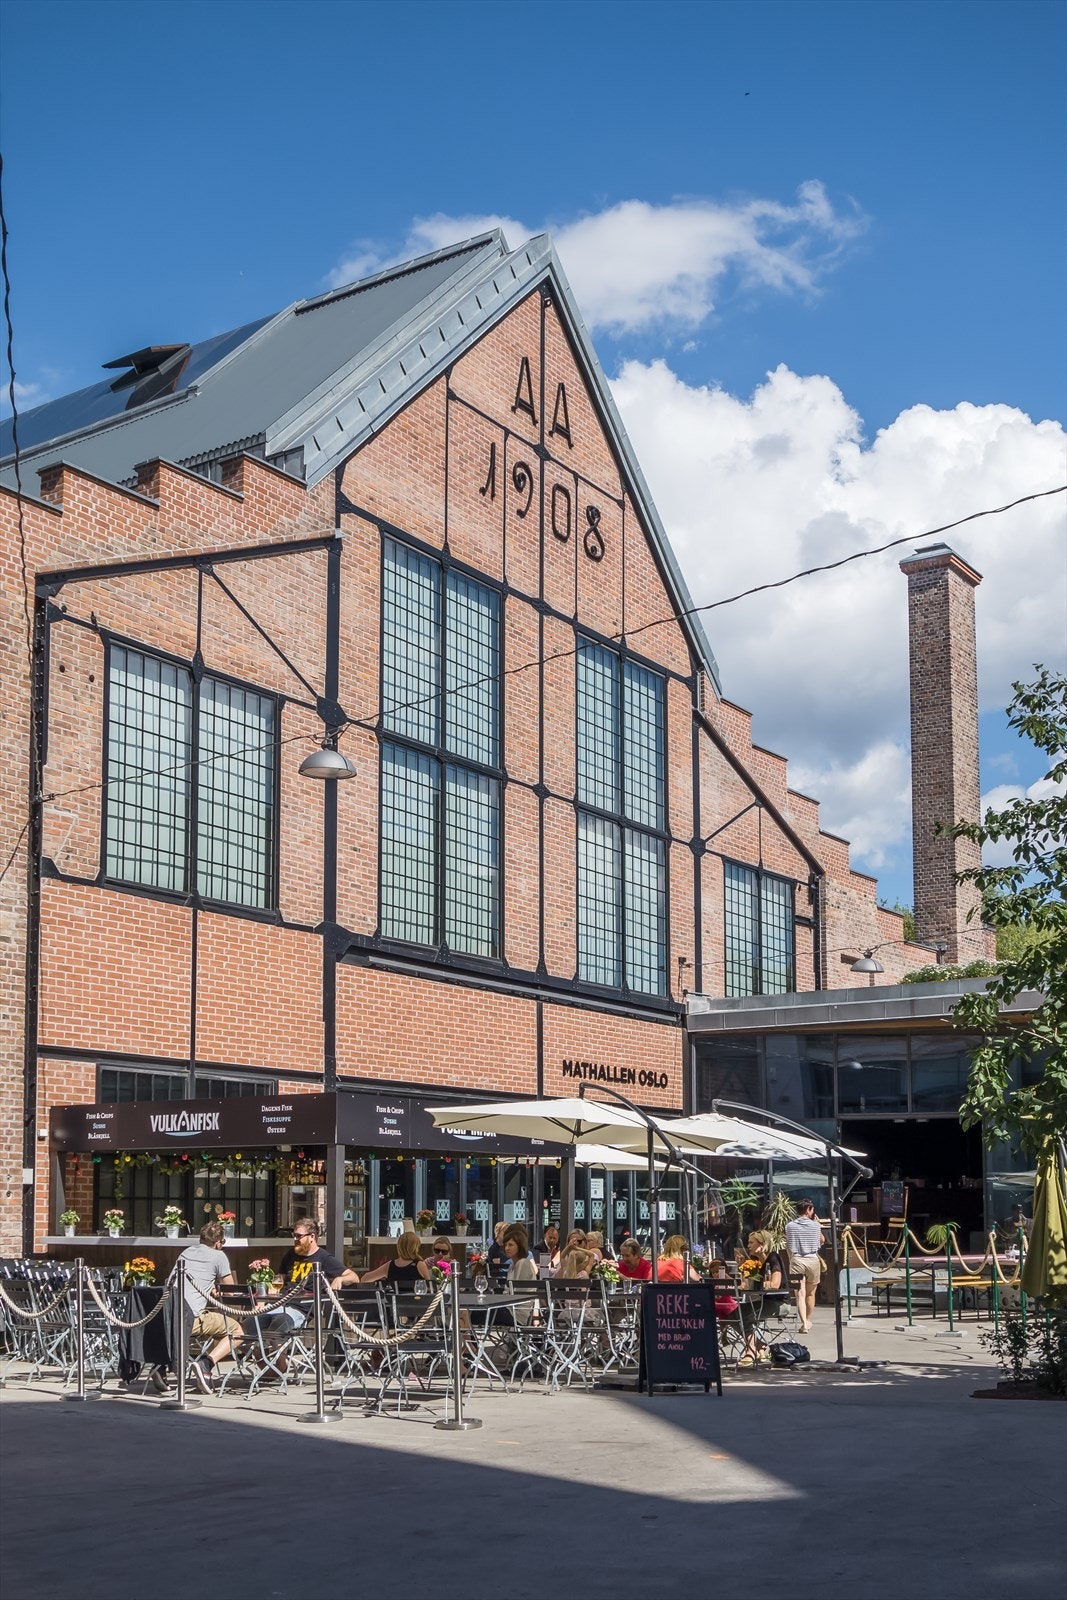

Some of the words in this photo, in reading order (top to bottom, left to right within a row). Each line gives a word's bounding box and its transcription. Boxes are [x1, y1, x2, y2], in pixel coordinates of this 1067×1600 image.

[479, 442, 605, 562] 1908
[562, 1060, 636, 1085] MATHALLEN
[638, 1069, 668, 1089] OSLO
[150, 1110, 220, 1133] VULKANFISK
[656, 1294, 690, 1315] REKE
[656, 1318, 705, 1330] TALLERKEN
